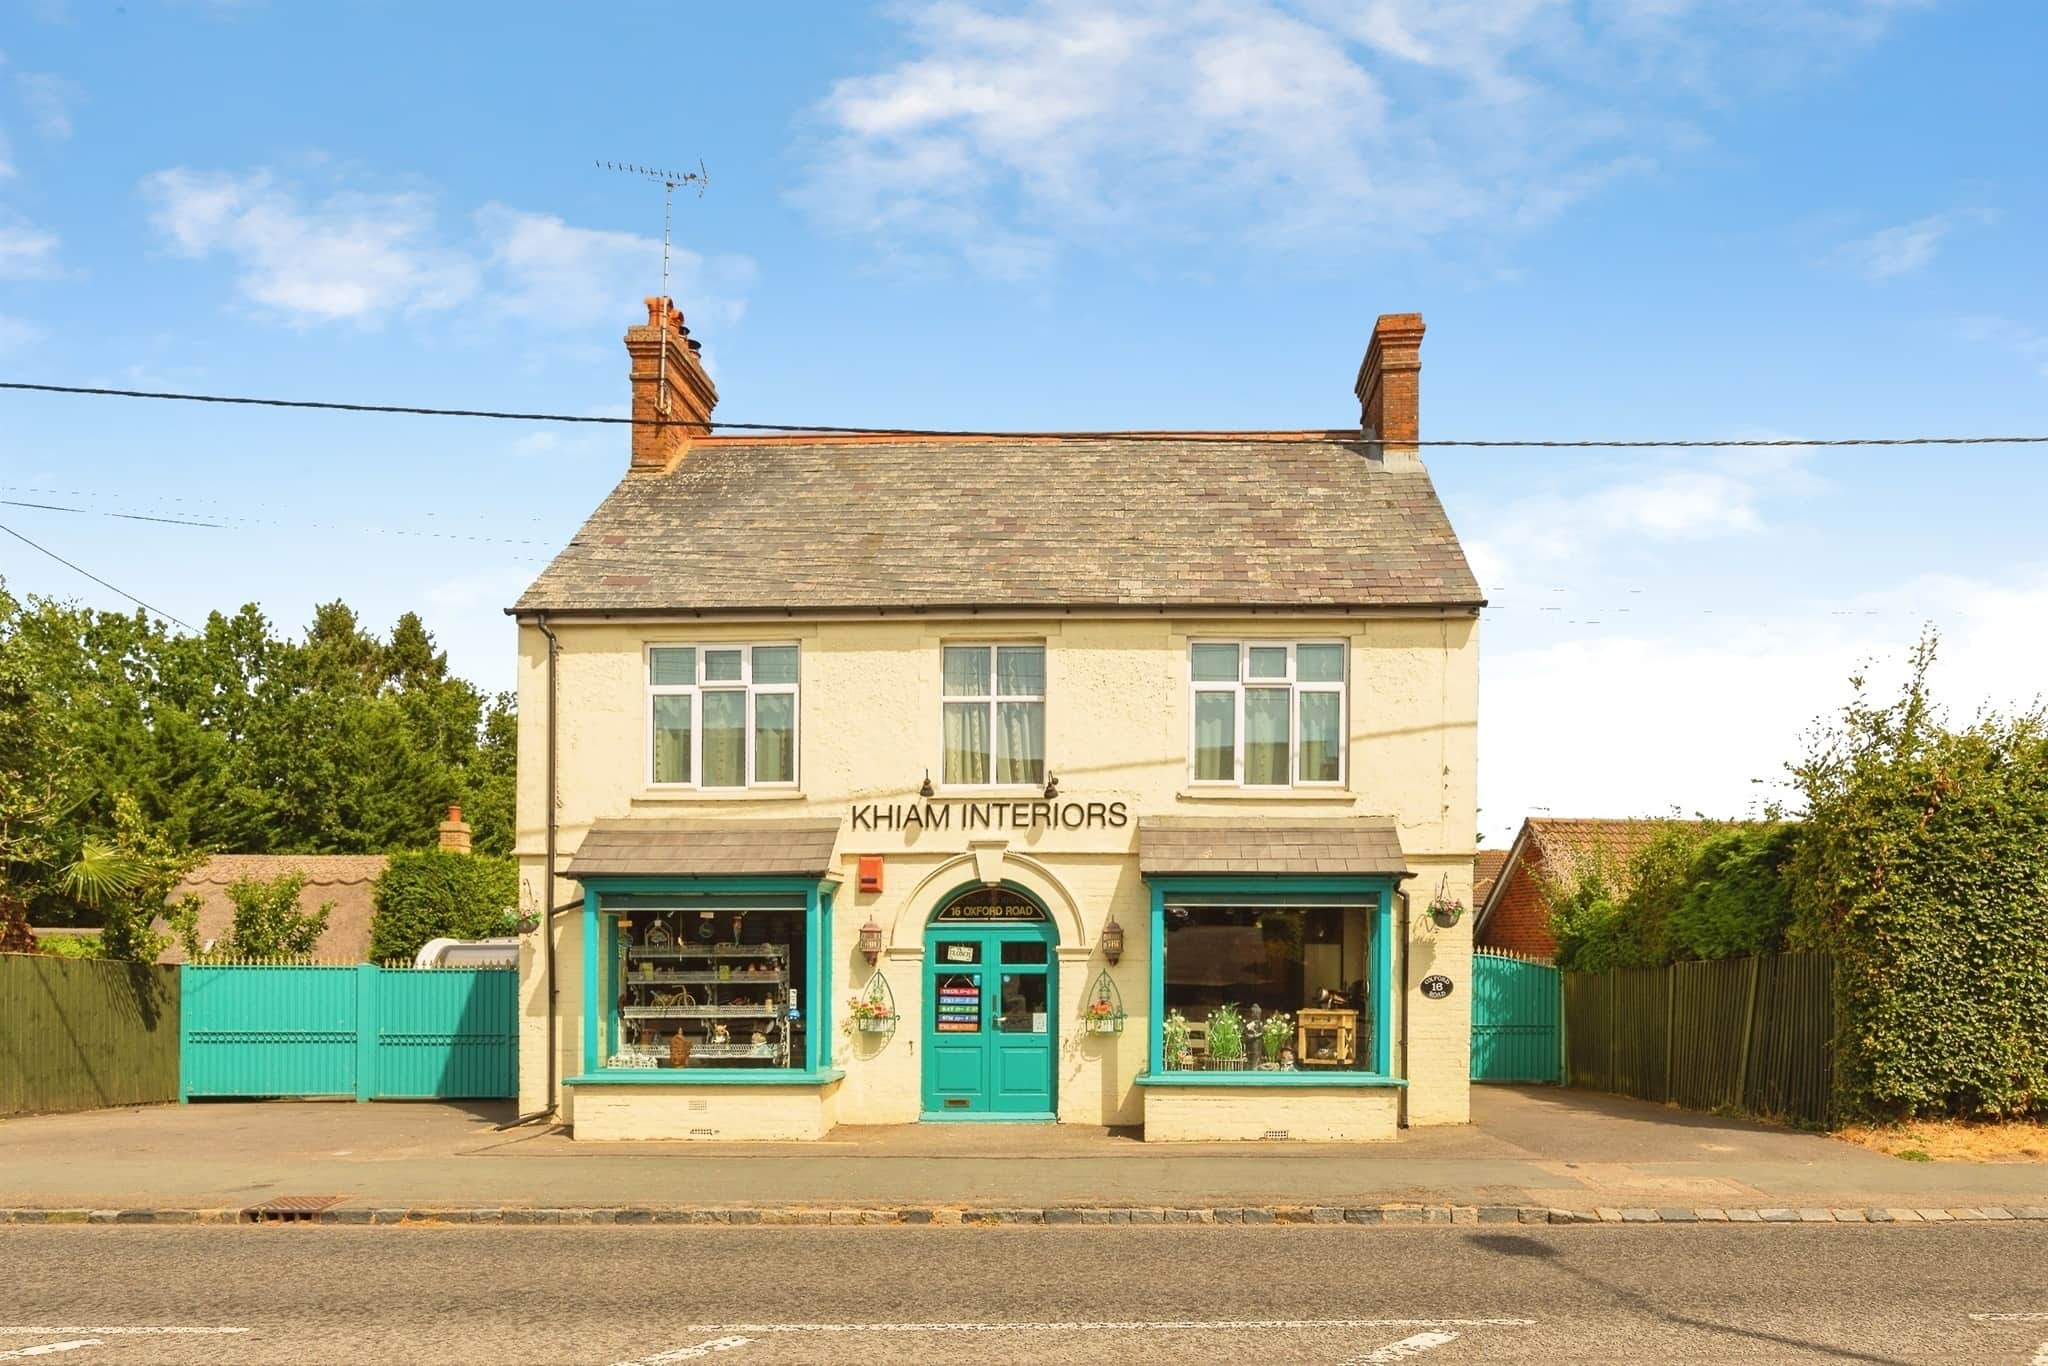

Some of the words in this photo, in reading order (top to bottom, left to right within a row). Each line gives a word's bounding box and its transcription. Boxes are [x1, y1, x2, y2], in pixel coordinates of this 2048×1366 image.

[852, 803, 950, 829] KHIAM
[961, 802, 1128, 828] INTERIORS
[951, 906, 961, 916] 16
[963, 906, 1003, 916] OXFORD
[1005, 906, 1033, 916] ROAD
[1424, 976, 1449, 985] OXFORD
